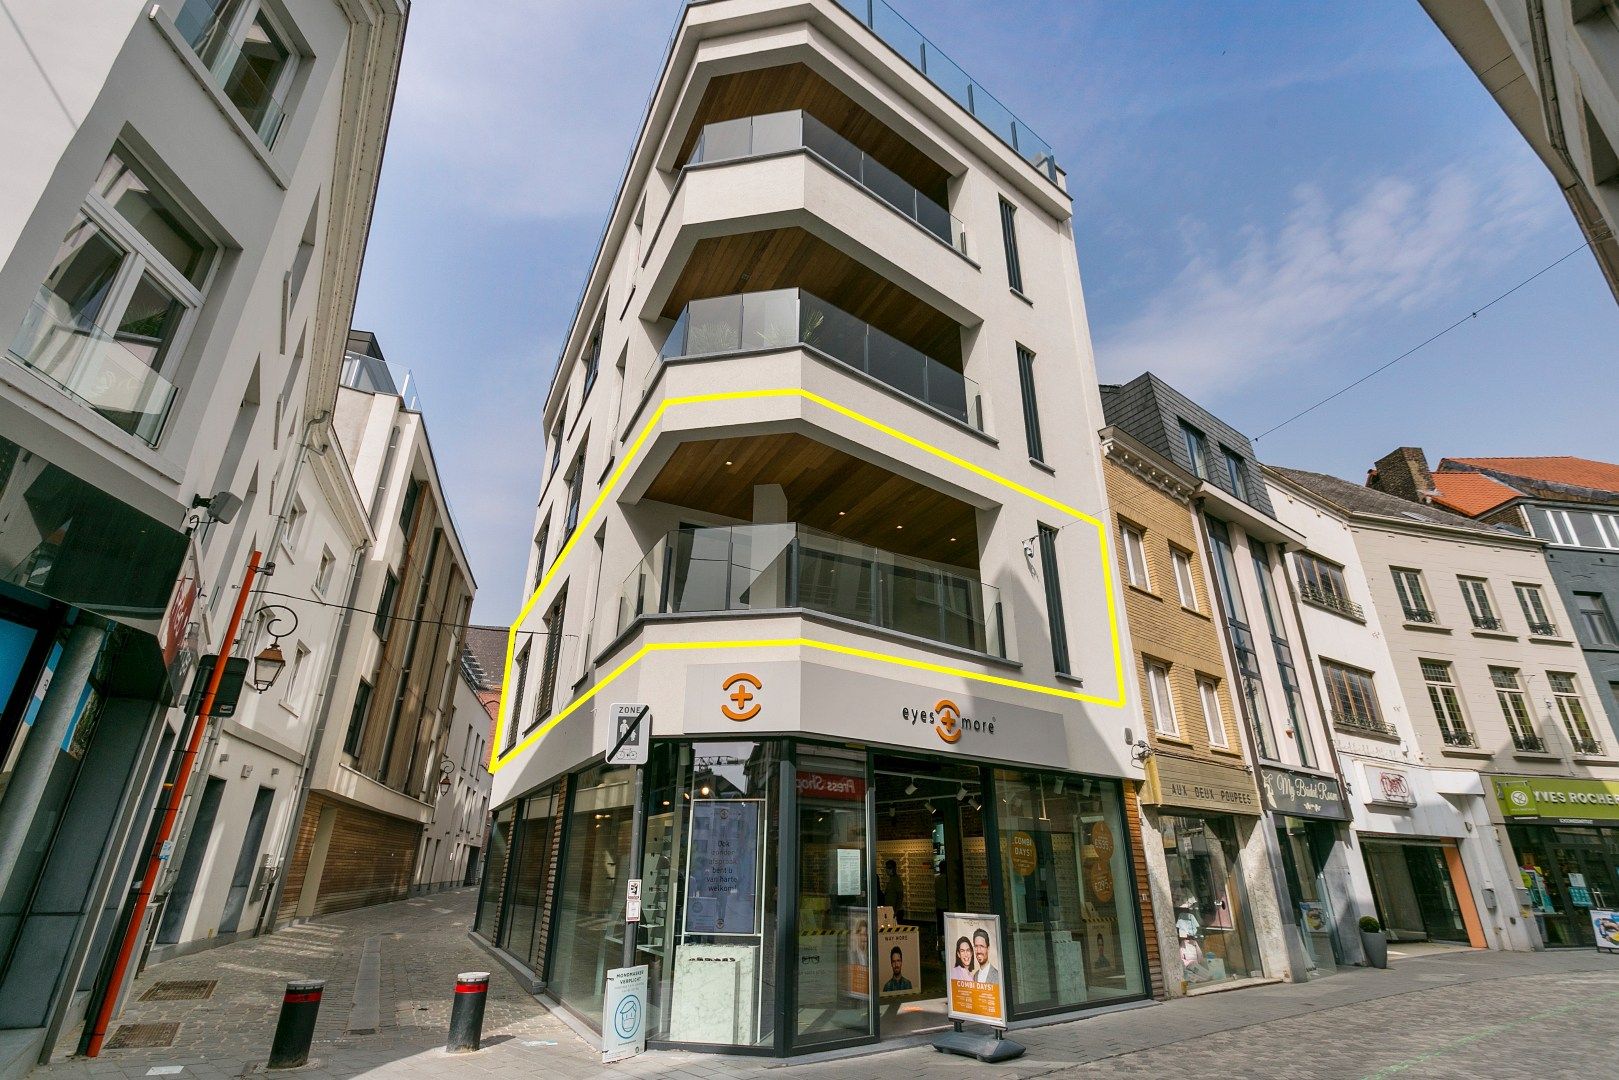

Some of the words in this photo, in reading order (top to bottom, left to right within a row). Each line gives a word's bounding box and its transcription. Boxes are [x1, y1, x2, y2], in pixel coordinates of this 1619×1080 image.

[618, 706, 643, 714] ZONE
[902, 707, 935, 725] eyes
[1171, 783, 1188, 797] AUX
[1194, 786, 1215, 800] DEUX
[1220, 790, 1252, 805] POUPEES
[1276, 774, 1296, 801] My
[1295, 778, 1319, 799] Bridal
[1317, 782, 1339, 801] Room
[1532, 790, 1567, 803] YVES
[956, 980, 975, 989] COMBI
[976, 982, 994, 991] DAYS!
